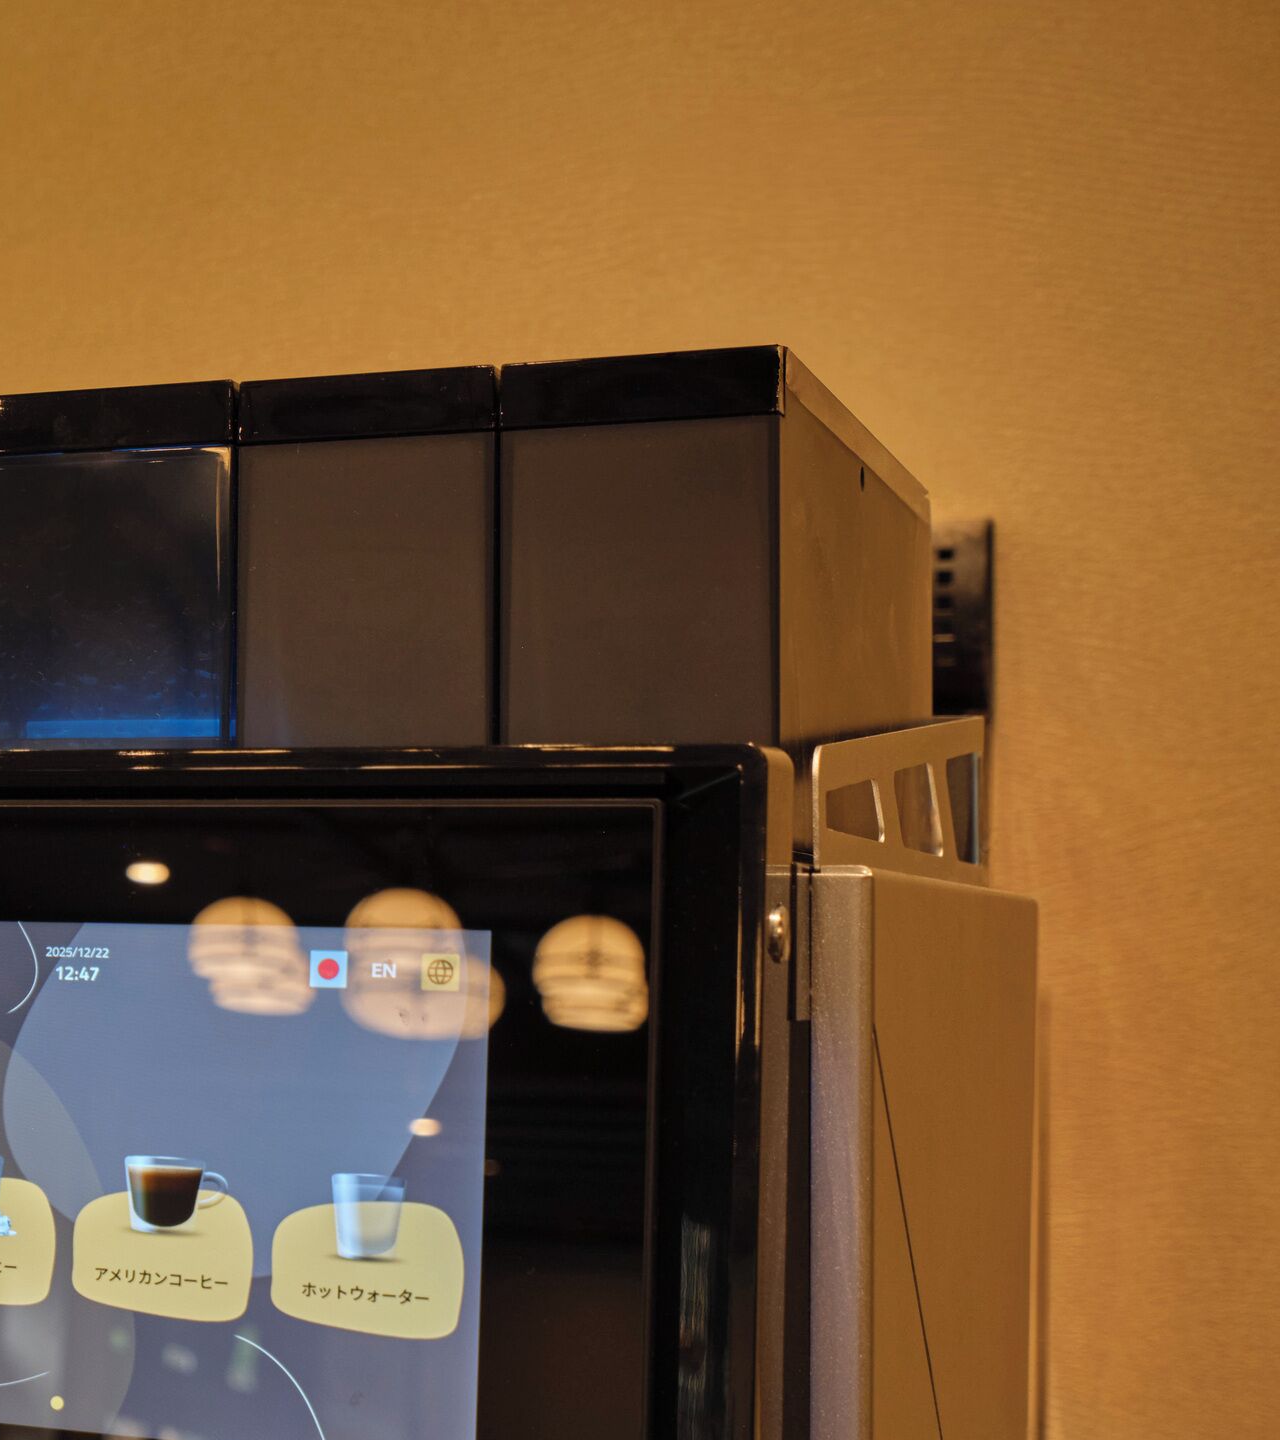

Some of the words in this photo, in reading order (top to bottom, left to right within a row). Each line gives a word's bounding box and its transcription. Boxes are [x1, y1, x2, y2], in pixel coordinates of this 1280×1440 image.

[45, 946, 109, 958] 2025/12/22
[56, 966, 100, 981] 12:47
[371, 962, 397, 978] EN
[94, 1266, 229, 1290] アメリカンコーヒー
[301, 1282, 430, 1304] ホットウォーター
